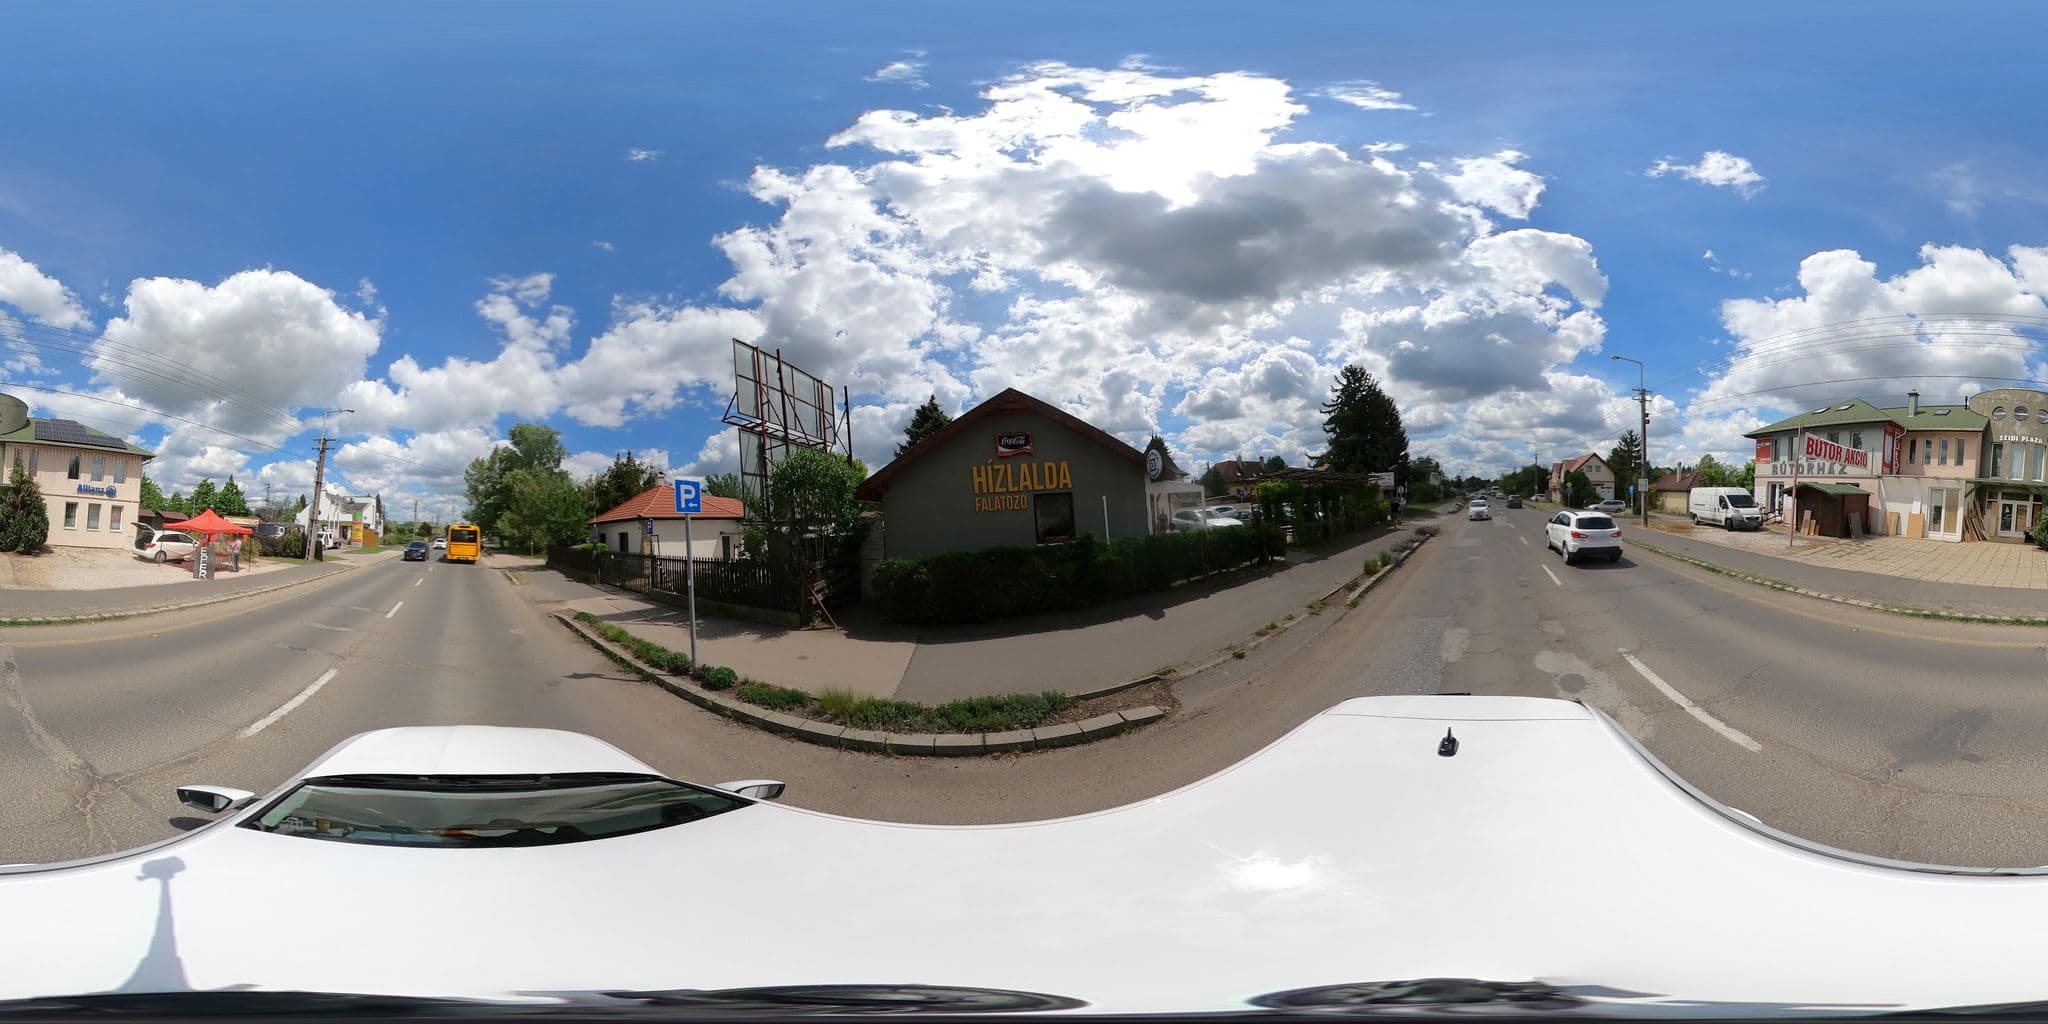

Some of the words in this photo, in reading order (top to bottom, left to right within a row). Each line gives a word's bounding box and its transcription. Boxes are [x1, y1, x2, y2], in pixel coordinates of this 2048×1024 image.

[1999, 434, 2019, 443] SZIDI
[2021, 436, 2043, 444] PLAZA
[972, 459, 1072, 494] HÍZLALDA
[77, 484, 105, 493] Allianz
[680, 485, 696, 508] P
[975, 492, 1028, 512] FALATOZÓ
[646, 522, 652, 533] P
